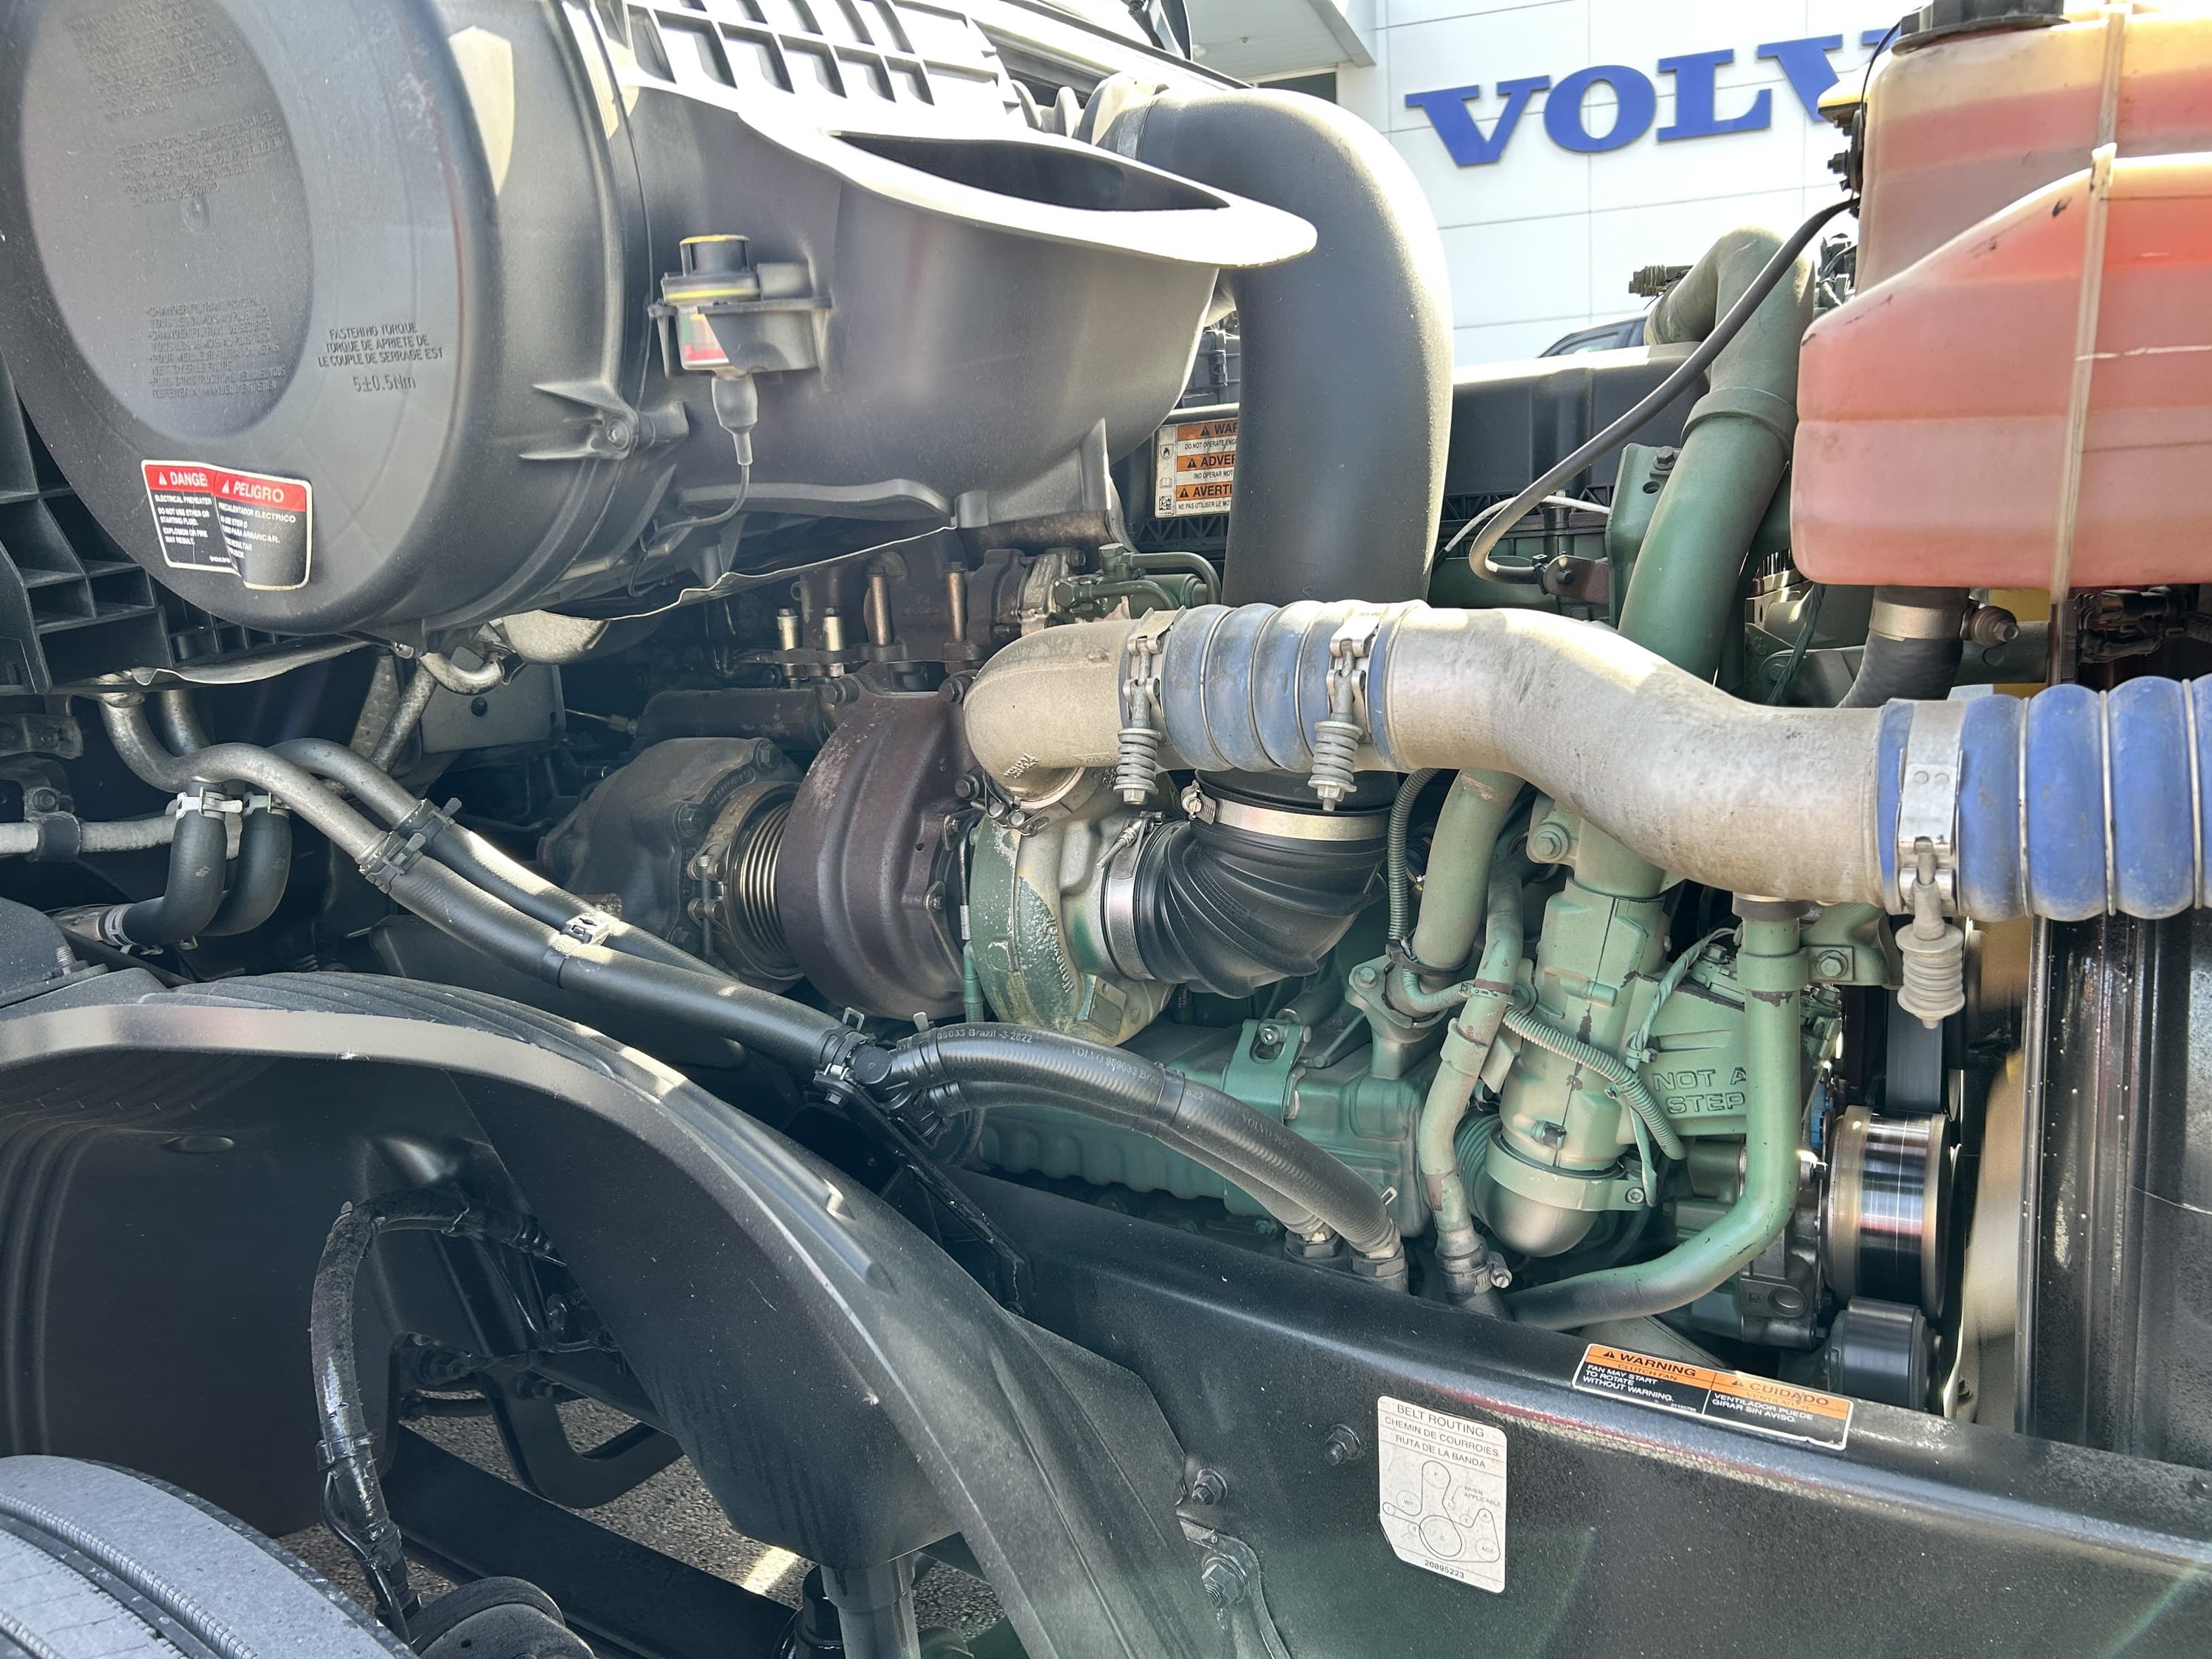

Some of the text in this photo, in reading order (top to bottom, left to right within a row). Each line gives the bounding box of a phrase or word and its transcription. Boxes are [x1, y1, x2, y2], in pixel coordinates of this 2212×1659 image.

[330, 322, 418, 340] FASTENING TORQUE
[326, 335, 431, 353] TORQUE DE APRIETE DE
[318, 347, 443, 367] LE COUPLE DE SERRAGE EST
[1203, 439, 1224, 448] OPERATE
[169, 471, 209, 487] DANGE
[233, 482, 285, 504] PELIGRO
[1193, 484, 1232, 497] AVERTI
[1195, 501, 1215, 509] UTILISER
[255, 510, 296, 524] ELECTRICO
[968, 1029, 996, 1037] Brazil
[1071, 1046, 1104, 1063] VOLVO
[1652, 1069, 1716, 1091] NOT
[1665, 1091, 1746, 1114] STEP
[1587, 1365, 1606, 1373] FAN
[1627, 1373, 1658, 1385] START
[1618, 1363, 1658, 1377] CLUTCH
[1620, 1353, 1697, 1377] WARNING
[1582, 1376, 1674, 1402] WITHOUT WARNING.
[1599, 1374, 1635, 1385] ROTATE
[1750, 1382, 1829, 1406] CUIDADO
[1711, 1399, 1796, 1423] GIRAR SIN AVISO.
[1714, 1393, 1814, 1420] VENTILADOR PUEDE
[1397, 1403, 1485, 1438] BELT ROUTING
[1385, 1416, 1499, 1457] CHEMIN DE COURROIES
[1396, 1435, 1486, 1469] RUTA DE LA BANDA
[1464, 1486, 1484, 1495] WHEN
[1464, 1493, 1501, 1507] APPLICABLE
[1425, 1559, 1465, 1579] 20895223
